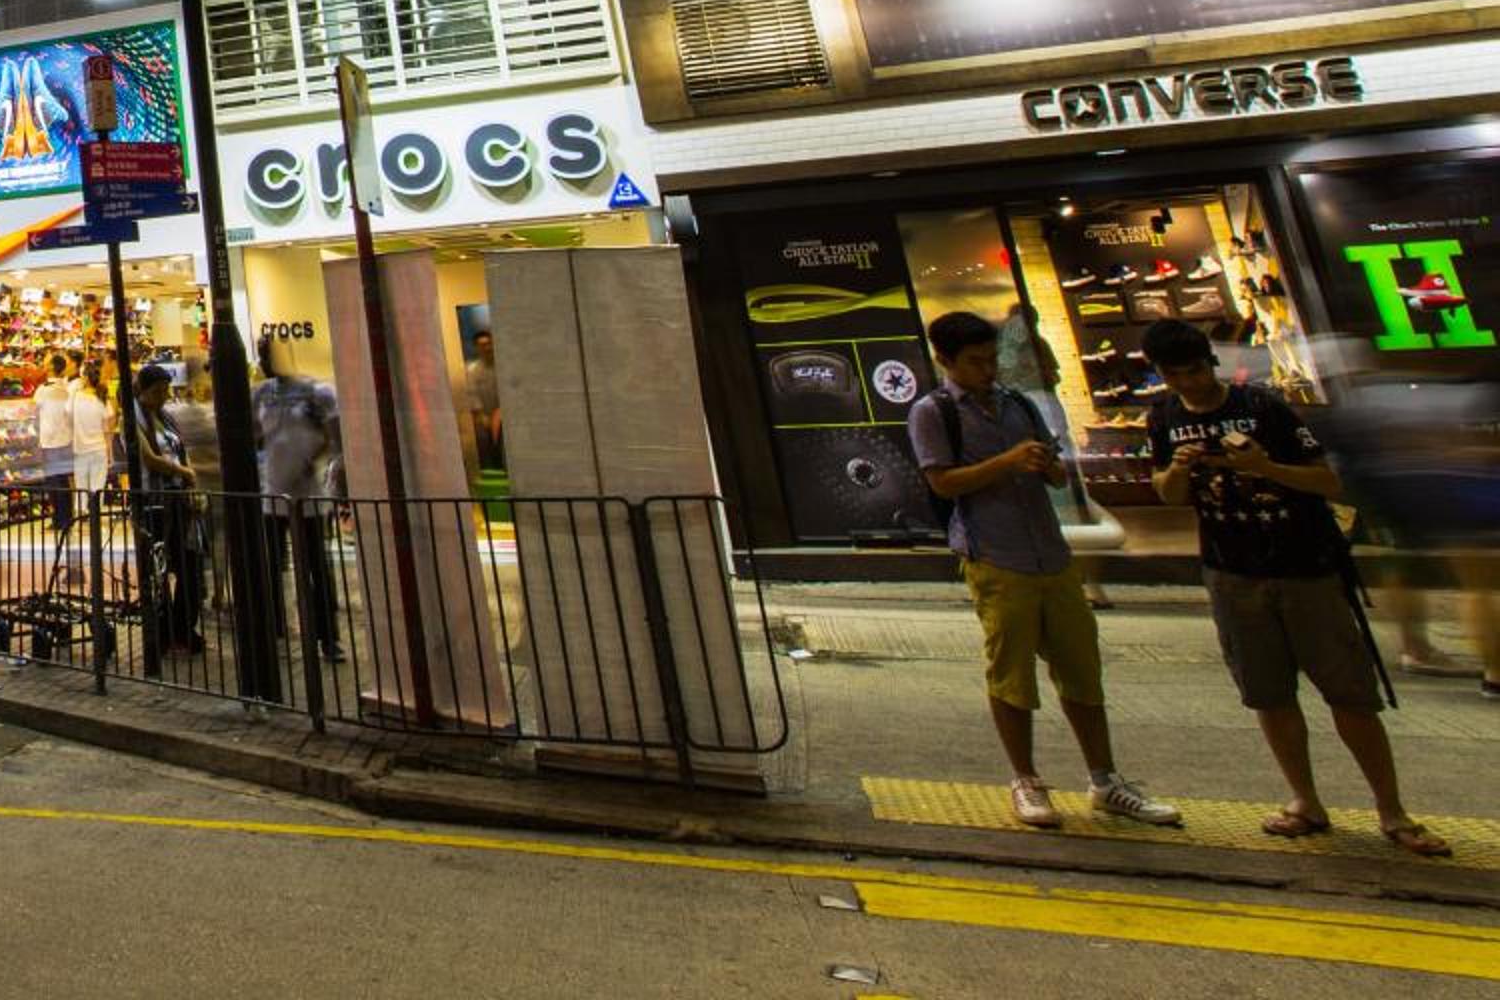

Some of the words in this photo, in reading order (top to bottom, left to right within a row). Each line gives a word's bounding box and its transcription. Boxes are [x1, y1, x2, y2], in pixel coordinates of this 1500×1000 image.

[1020, 56, 1364, 132] CONVERSE
[244, 113, 609, 210] crocs
[783, 245, 829, 260] CHUCK
[830, 241, 879, 254] TAYLOR
[798, 255, 820, 268] ALL
[822, 252, 857, 266] STAR
[261, 319, 314, 342] crocs
